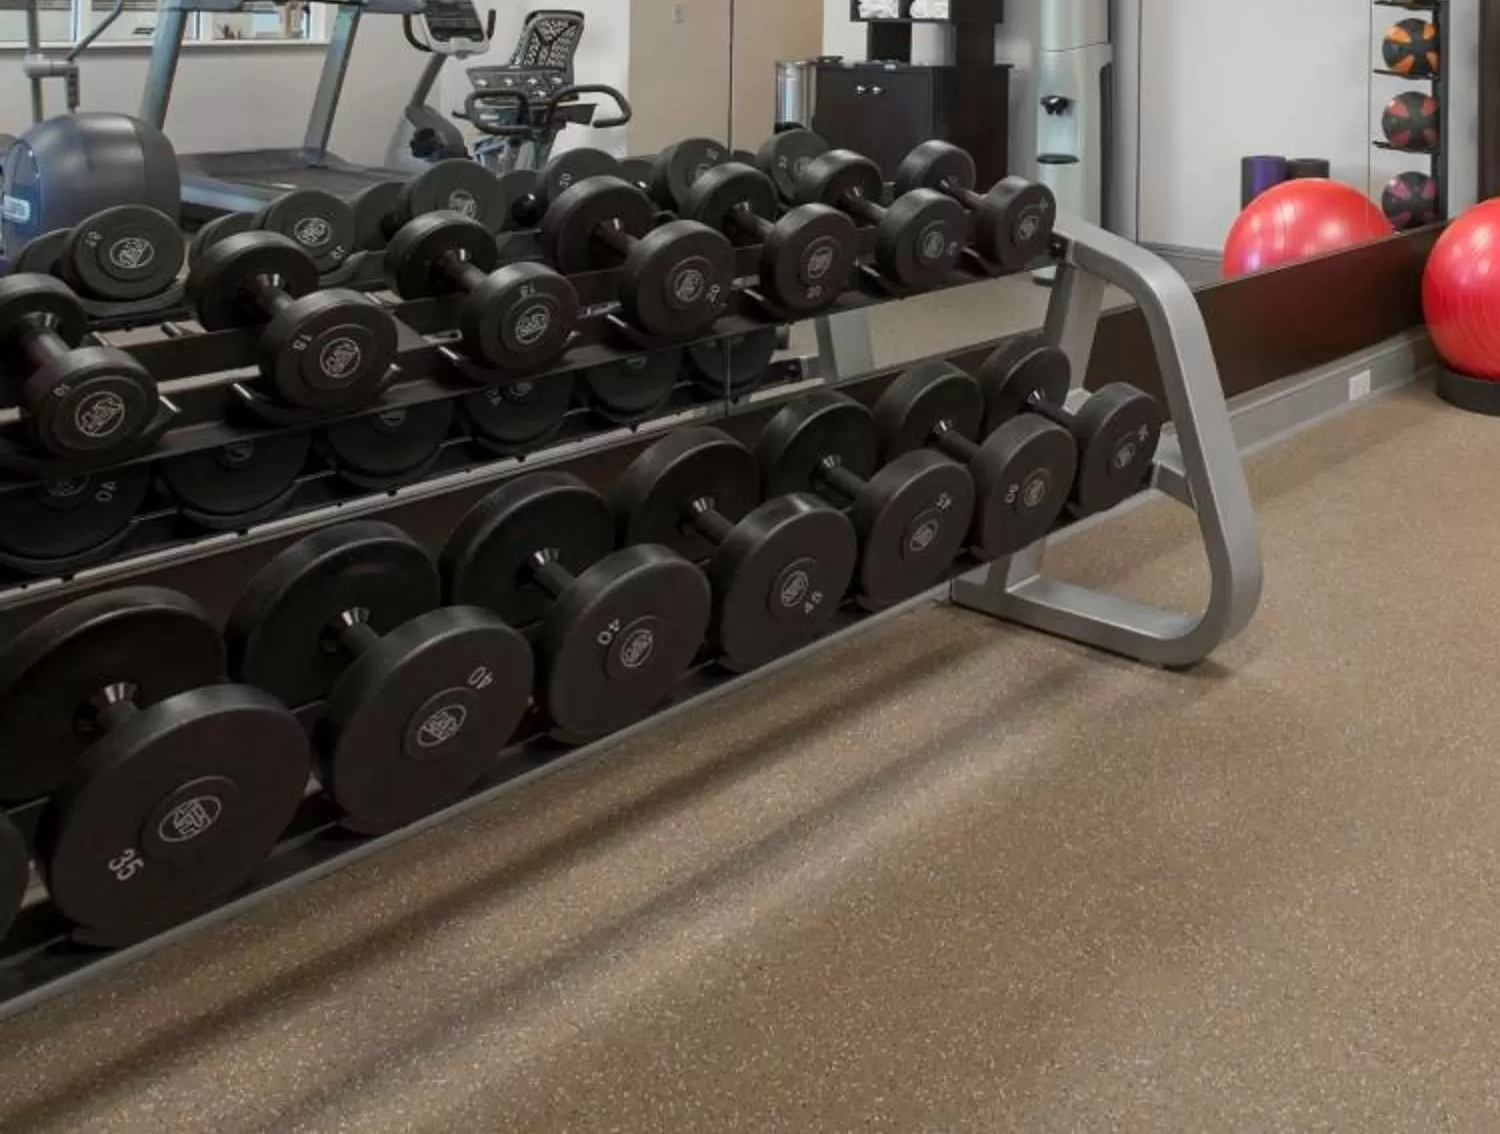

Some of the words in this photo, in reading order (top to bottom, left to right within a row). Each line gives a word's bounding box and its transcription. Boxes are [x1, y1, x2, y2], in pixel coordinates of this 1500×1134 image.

[596, 617, 621, 646] 40
[467, 664, 494, 690] 40
[107, 847, 145, 882] 35
